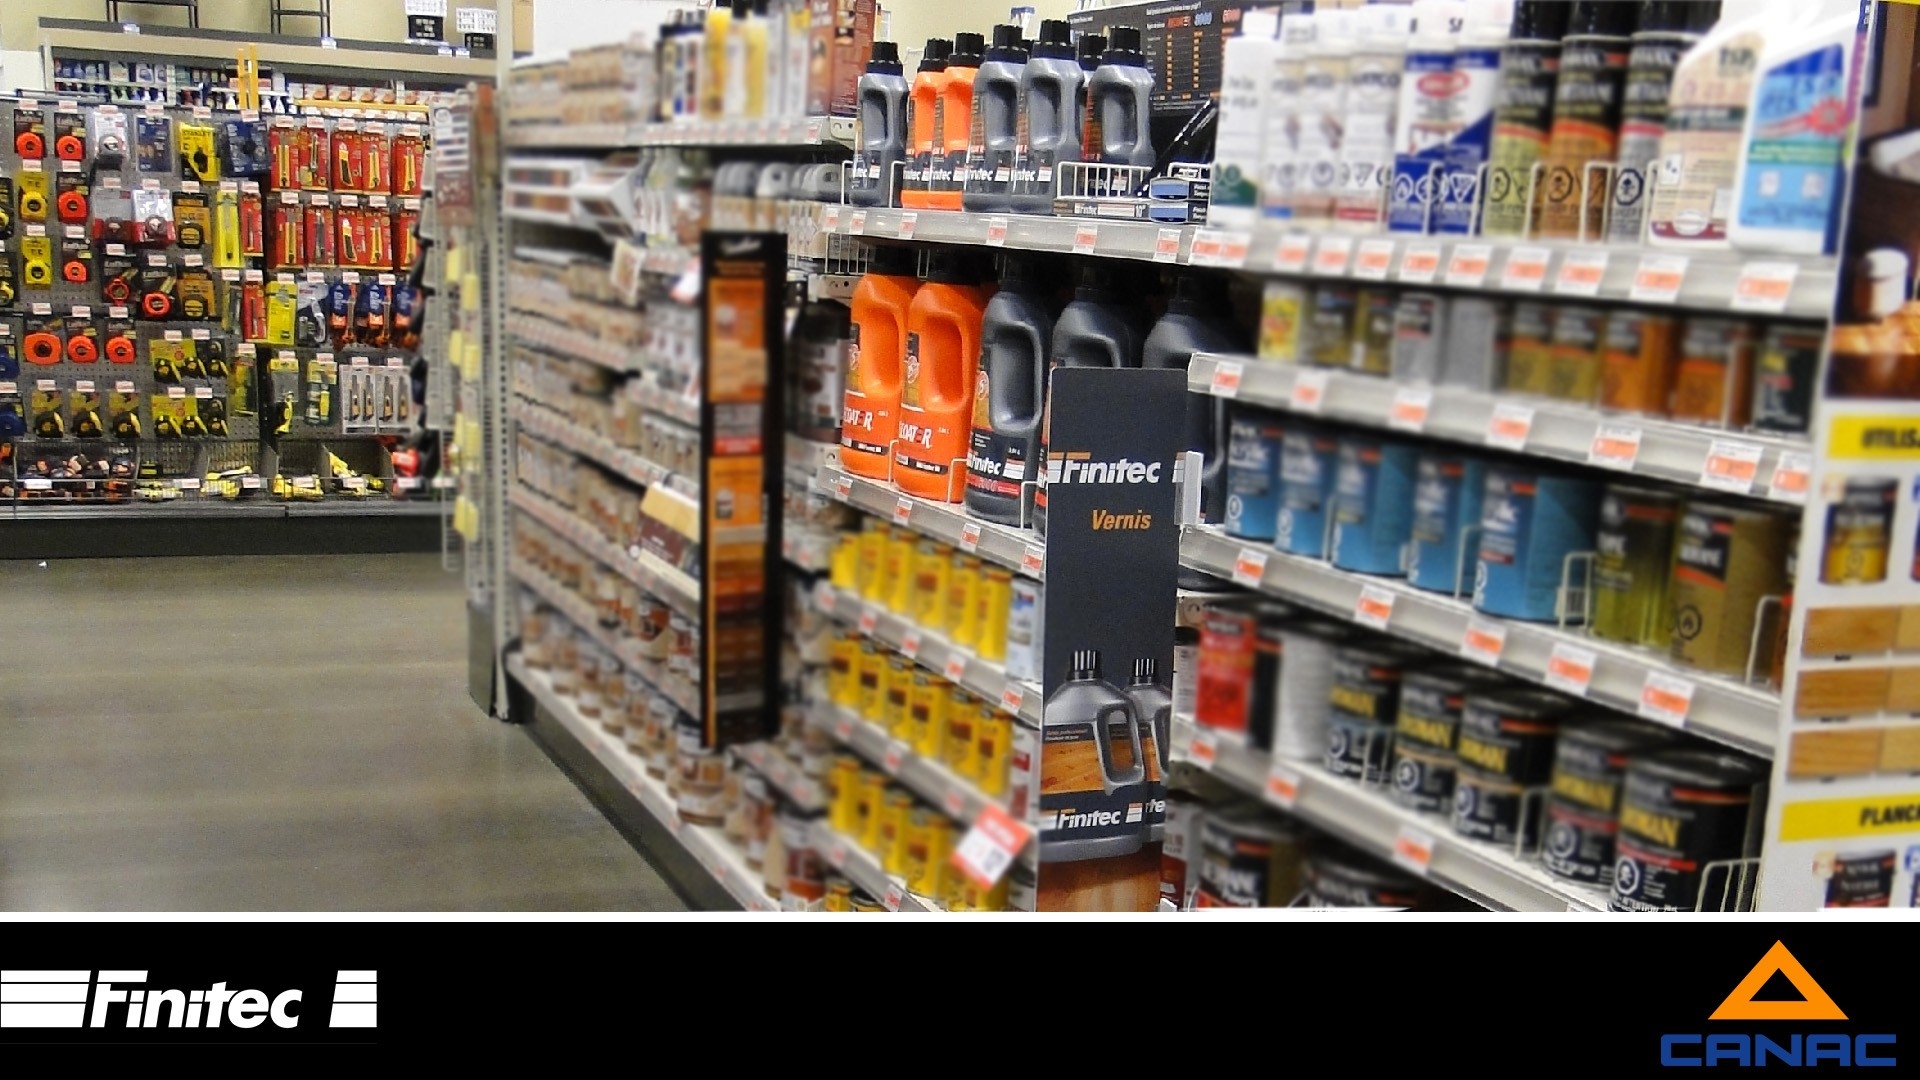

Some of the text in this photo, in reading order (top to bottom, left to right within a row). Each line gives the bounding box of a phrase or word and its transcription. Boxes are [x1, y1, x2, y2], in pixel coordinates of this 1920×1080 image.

[1063, 452, 1161, 484] Finitec
[1091, 509, 1152, 531] Vernis
[1057, 808, 1122, 831] Finitec
[1859, 804, 1920, 828] PLANC
